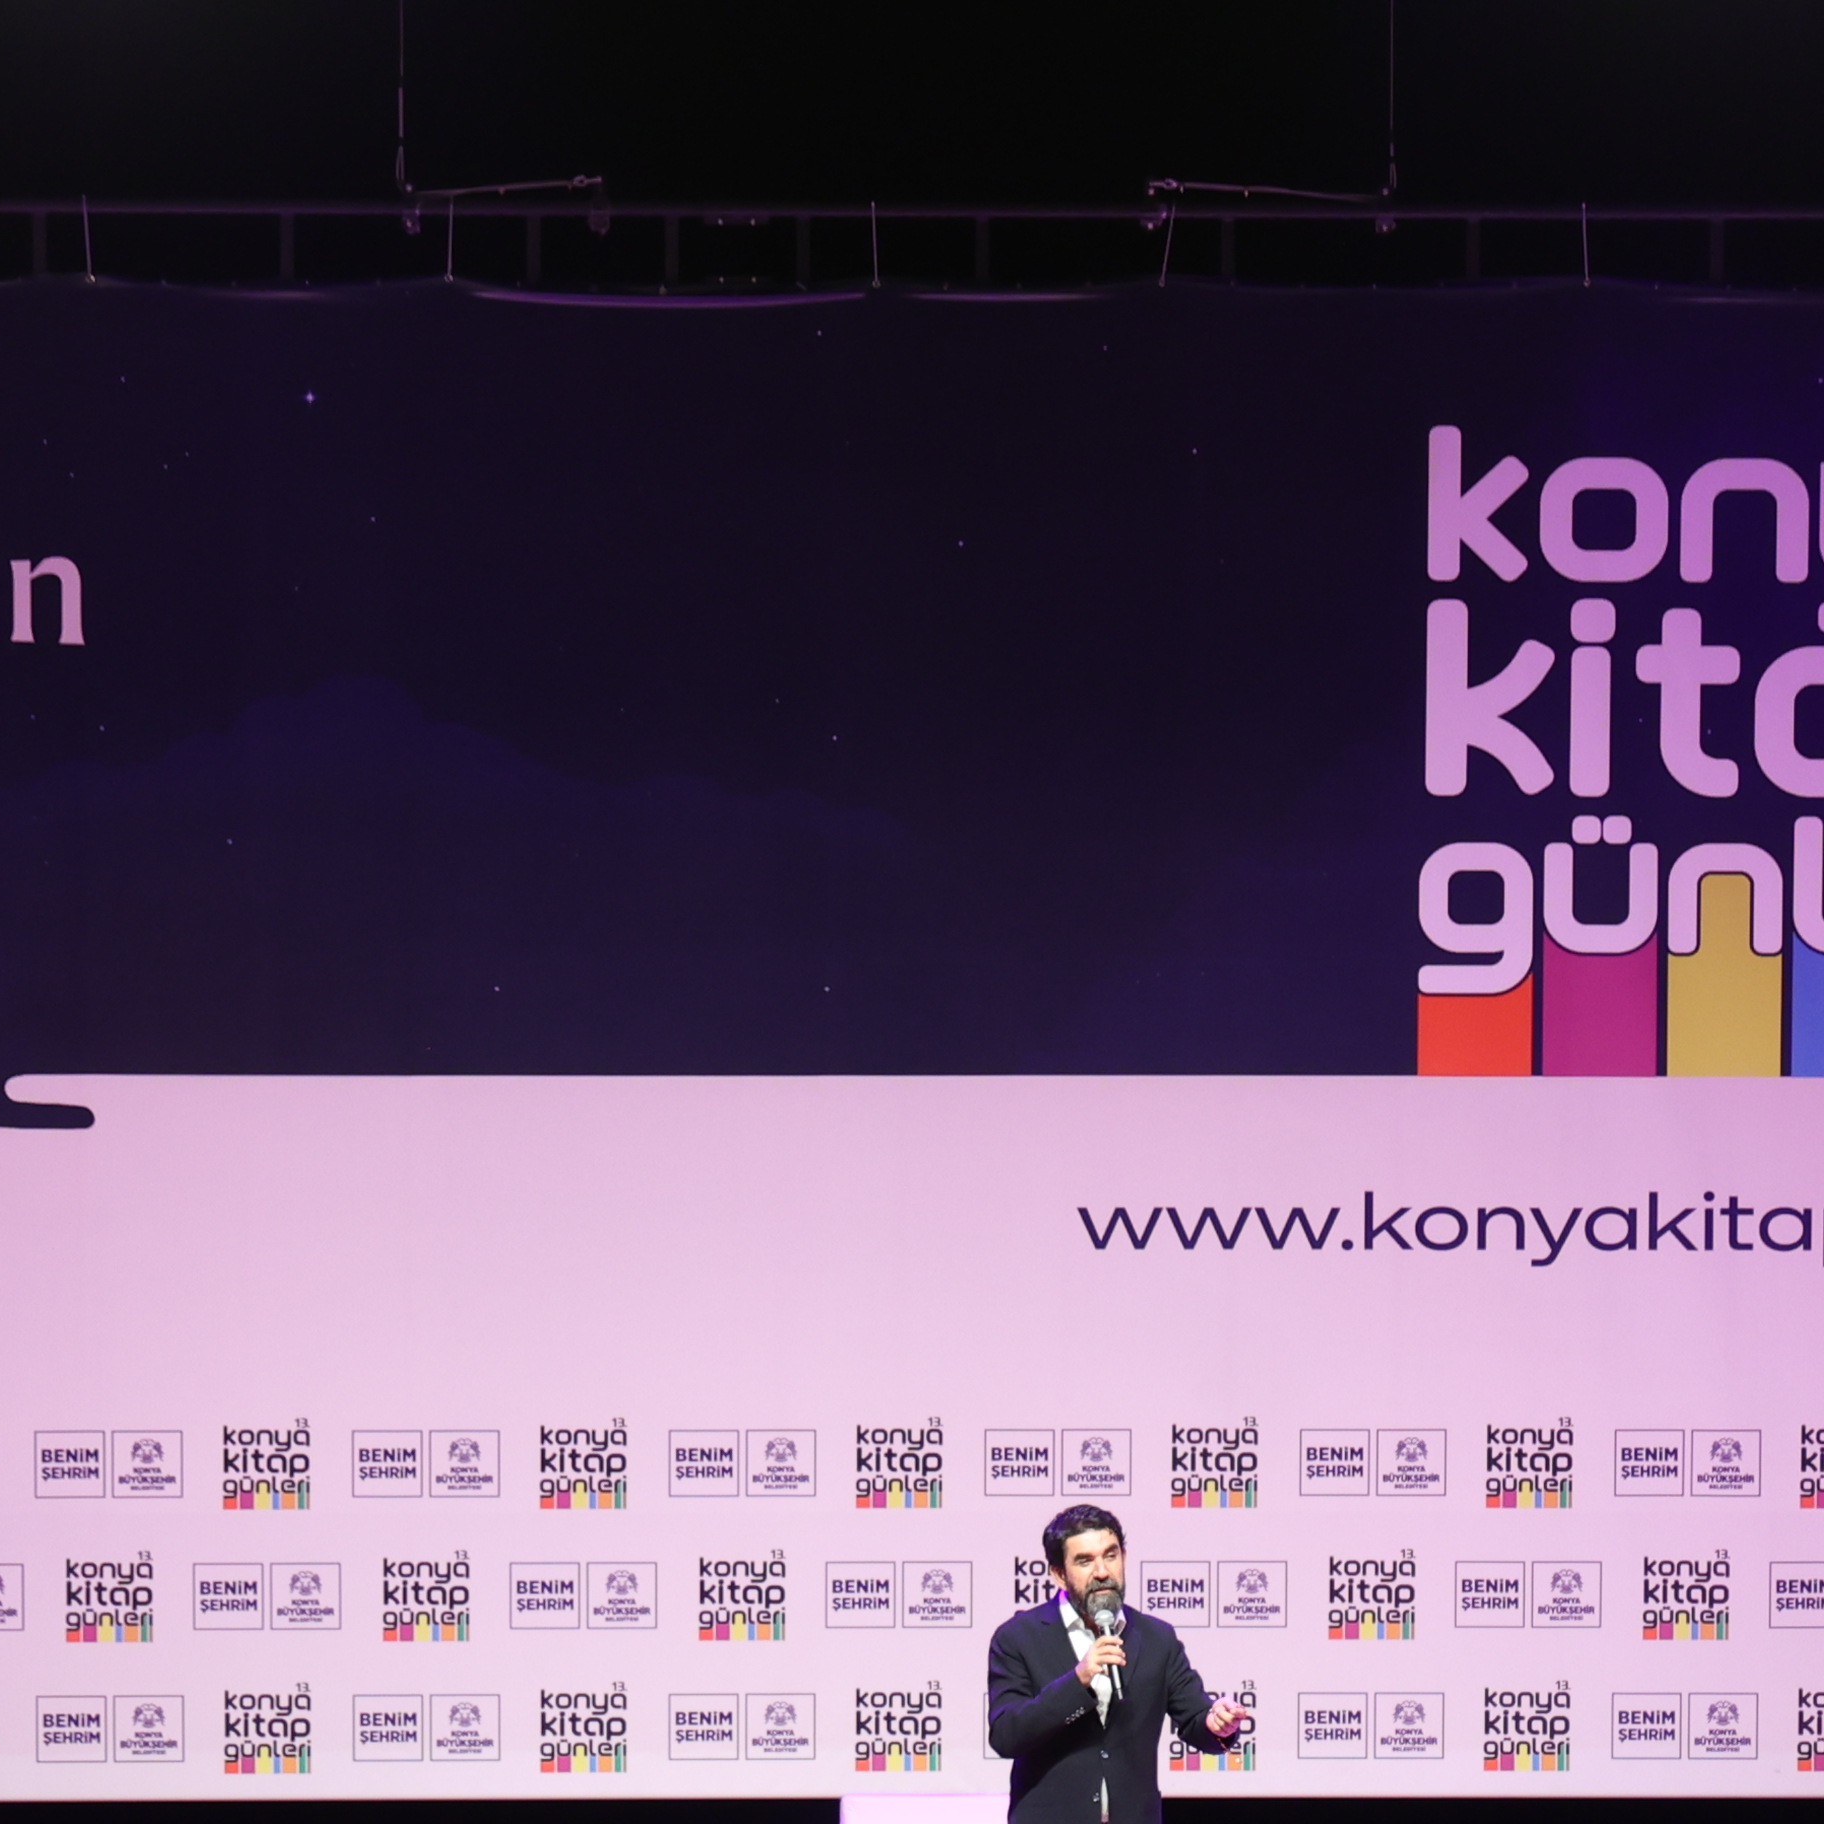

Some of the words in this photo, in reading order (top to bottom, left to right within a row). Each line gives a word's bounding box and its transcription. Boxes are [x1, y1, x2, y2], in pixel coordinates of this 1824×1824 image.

[223, 1425, 310, 1451] konya
[541, 1425, 627, 1451] konya
[856, 1424, 943, 1450] konya
[1172, 1424, 1258, 1450] konya
[1487, 1424, 1573, 1450] konya
[223, 1447, 309, 1478] kitap
[541, 1447, 626, 1477] kitap
[856, 1446, 942, 1477] kitap
[1172, 1446, 1257, 1476] kitap
[1487, 1446, 1572, 1476] kitap
[66, 1558, 153, 1584] konya
[383, 1557, 470, 1583] konya
[1329, 1556, 1415, 1582] konya
[66, 1580, 152, 1611] kitap
[383, 1579, 469, 1610] kitap
[1329, 1578, 1414, 1608] kitap
[541, 1689, 627, 1715] konya
[1485, 1688, 1570, 1714] konya
[541, 1711, 626, 1741] kitap
[1485, 1710, 1569, 1739] kitap
